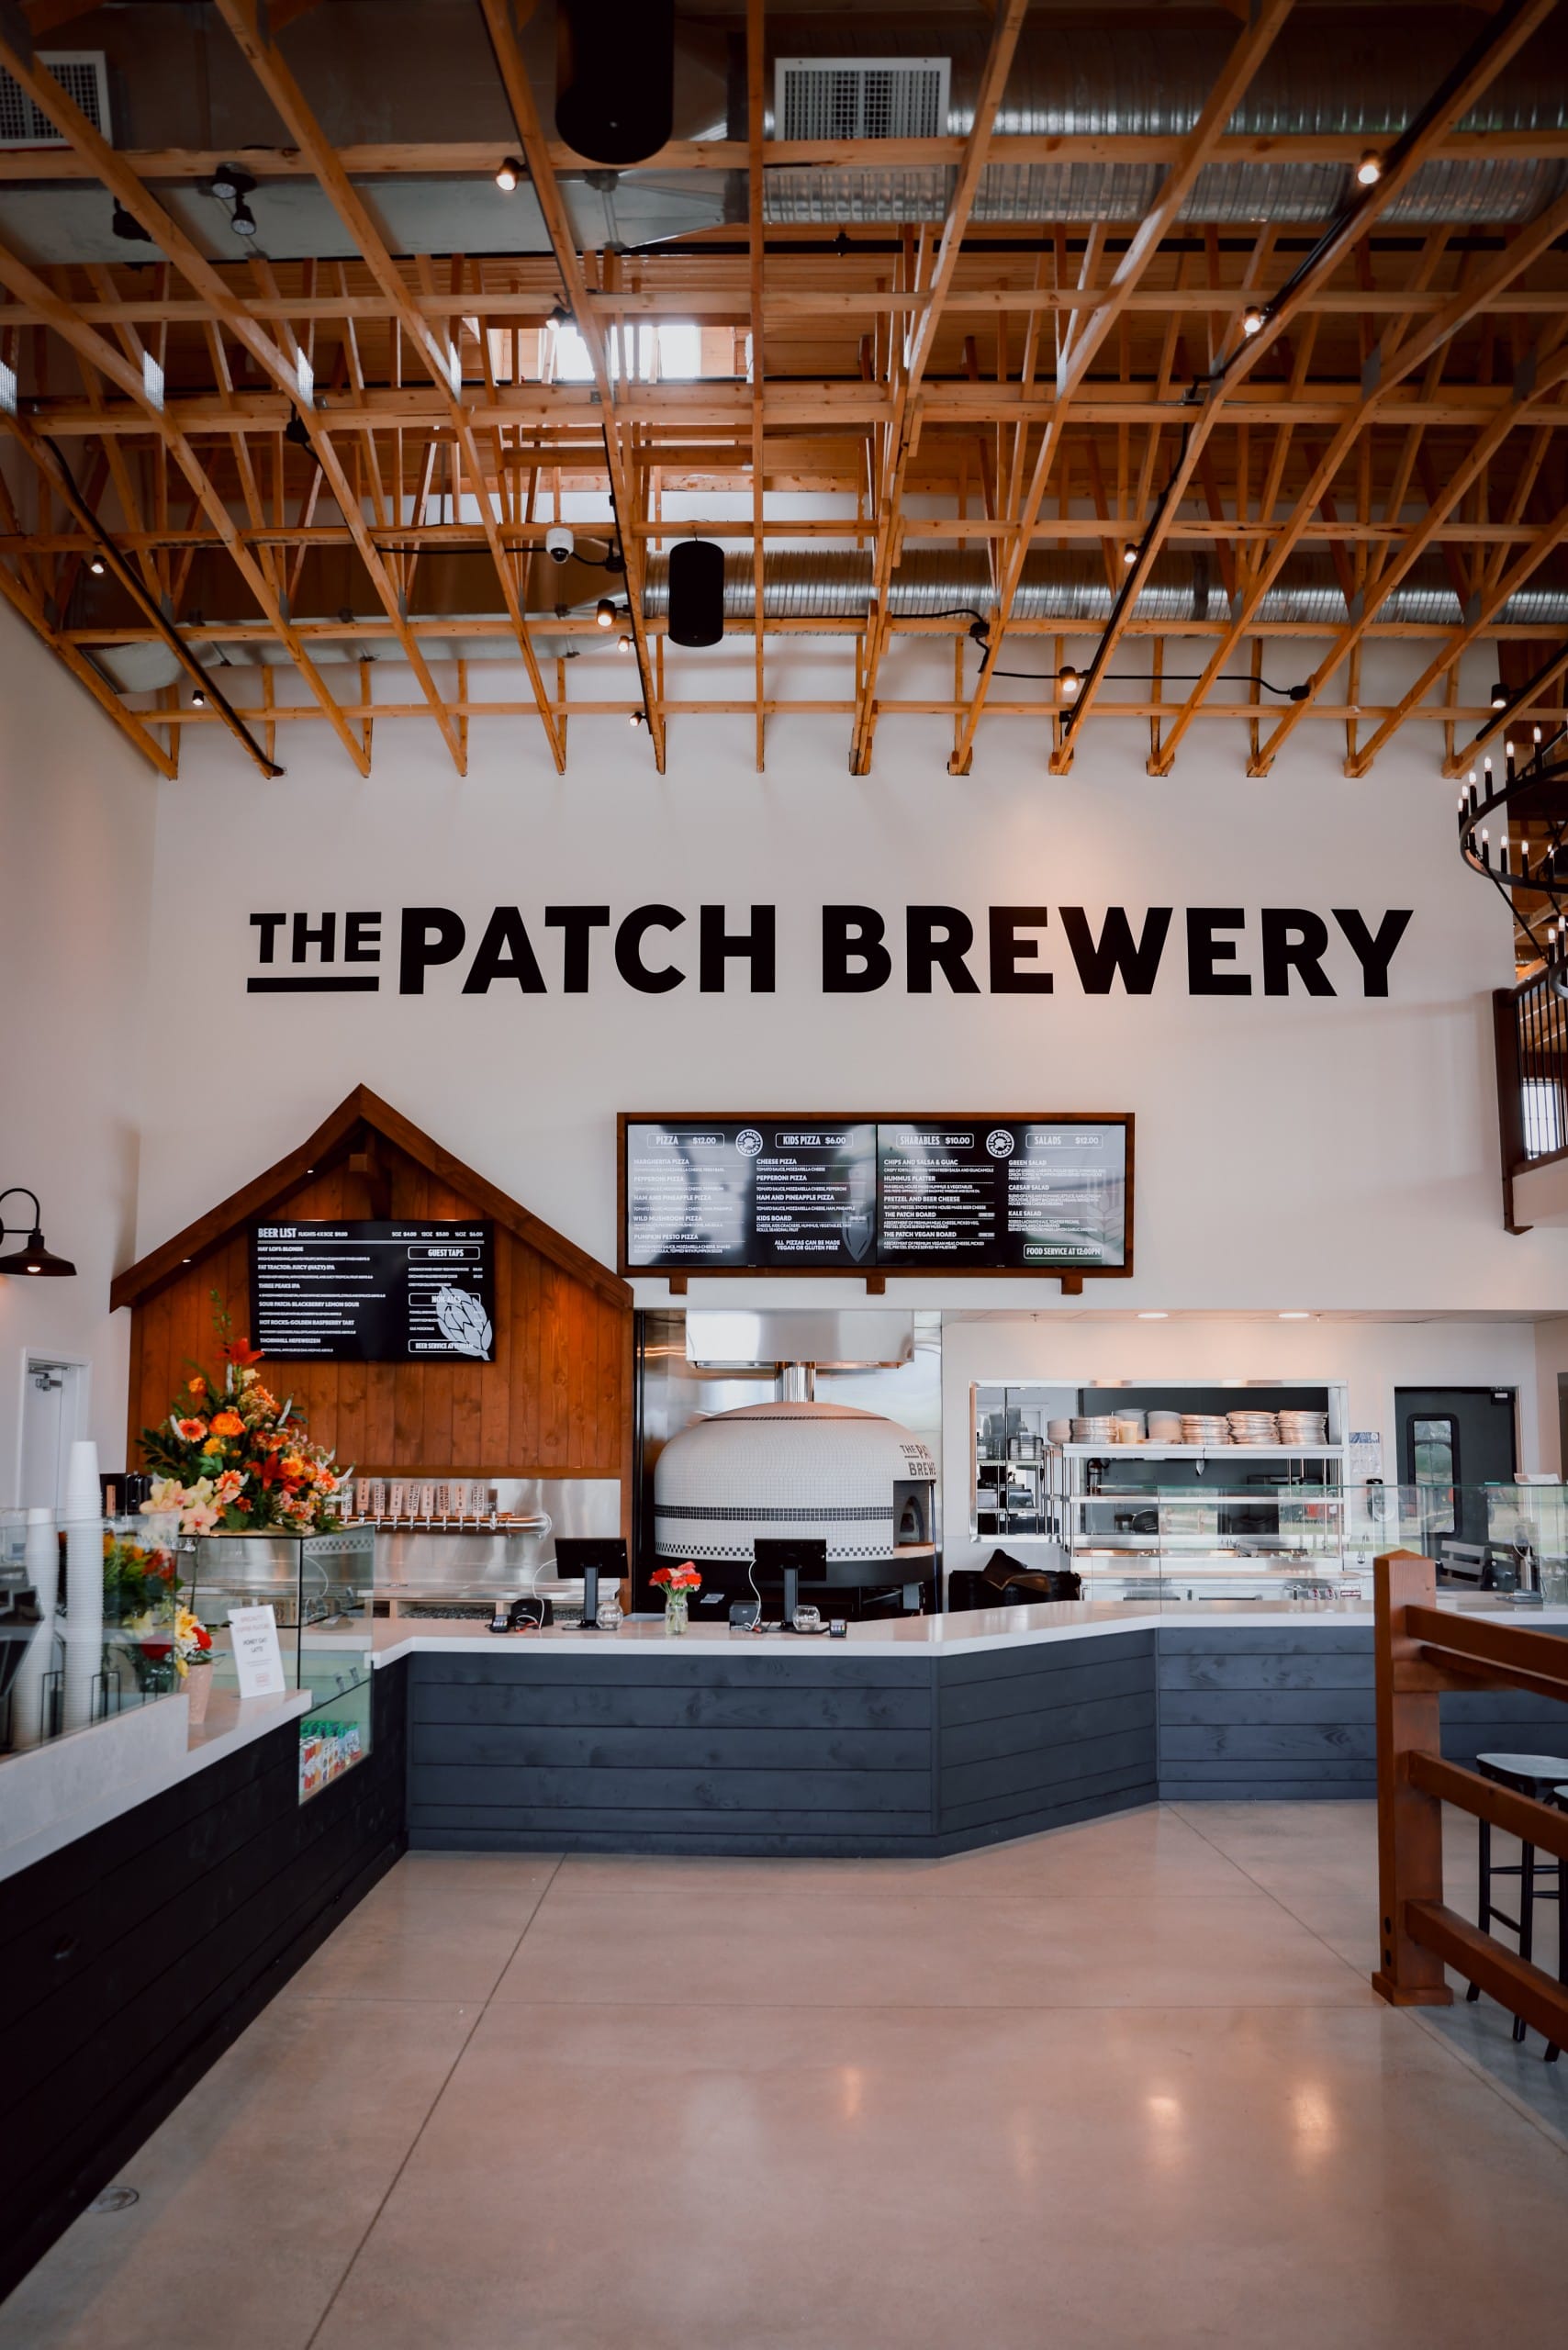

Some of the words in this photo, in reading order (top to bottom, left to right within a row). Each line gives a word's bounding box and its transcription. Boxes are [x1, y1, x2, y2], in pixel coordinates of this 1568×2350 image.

[250, 912, 382, 964] THE
[399, 903, 777, 995] PATCH
[823, 904, 1415, 999] BREWERY
[655, 1136, 679, 1146] PIZZA
[692, 1136, 716, 1146] $12.00
[782, 1136, 800, 1146] KIDS
[801, 1136, 821, 1146] PIZZA
[824, 1136, 846, 1146] $6.00
[901, 1136, 940, 1146] SHARABLES
[946, 1136, 970, 1146] $10.00
[1034, 1136, 1062, 1146] SALADS
[1075, 1136, 1099, 1146] $12.00
[258, 1228, 279, 1238] BEER
[279, 1228, 297, 1238] LIST
[1026, 1248, 1043, 1256] FOOD
[1044, 1248, 1068, 1256] SERVICE
[1069, 1248, 1076, 1256] AT
[1077, 1248, 1101, 1256] 12:00PM
